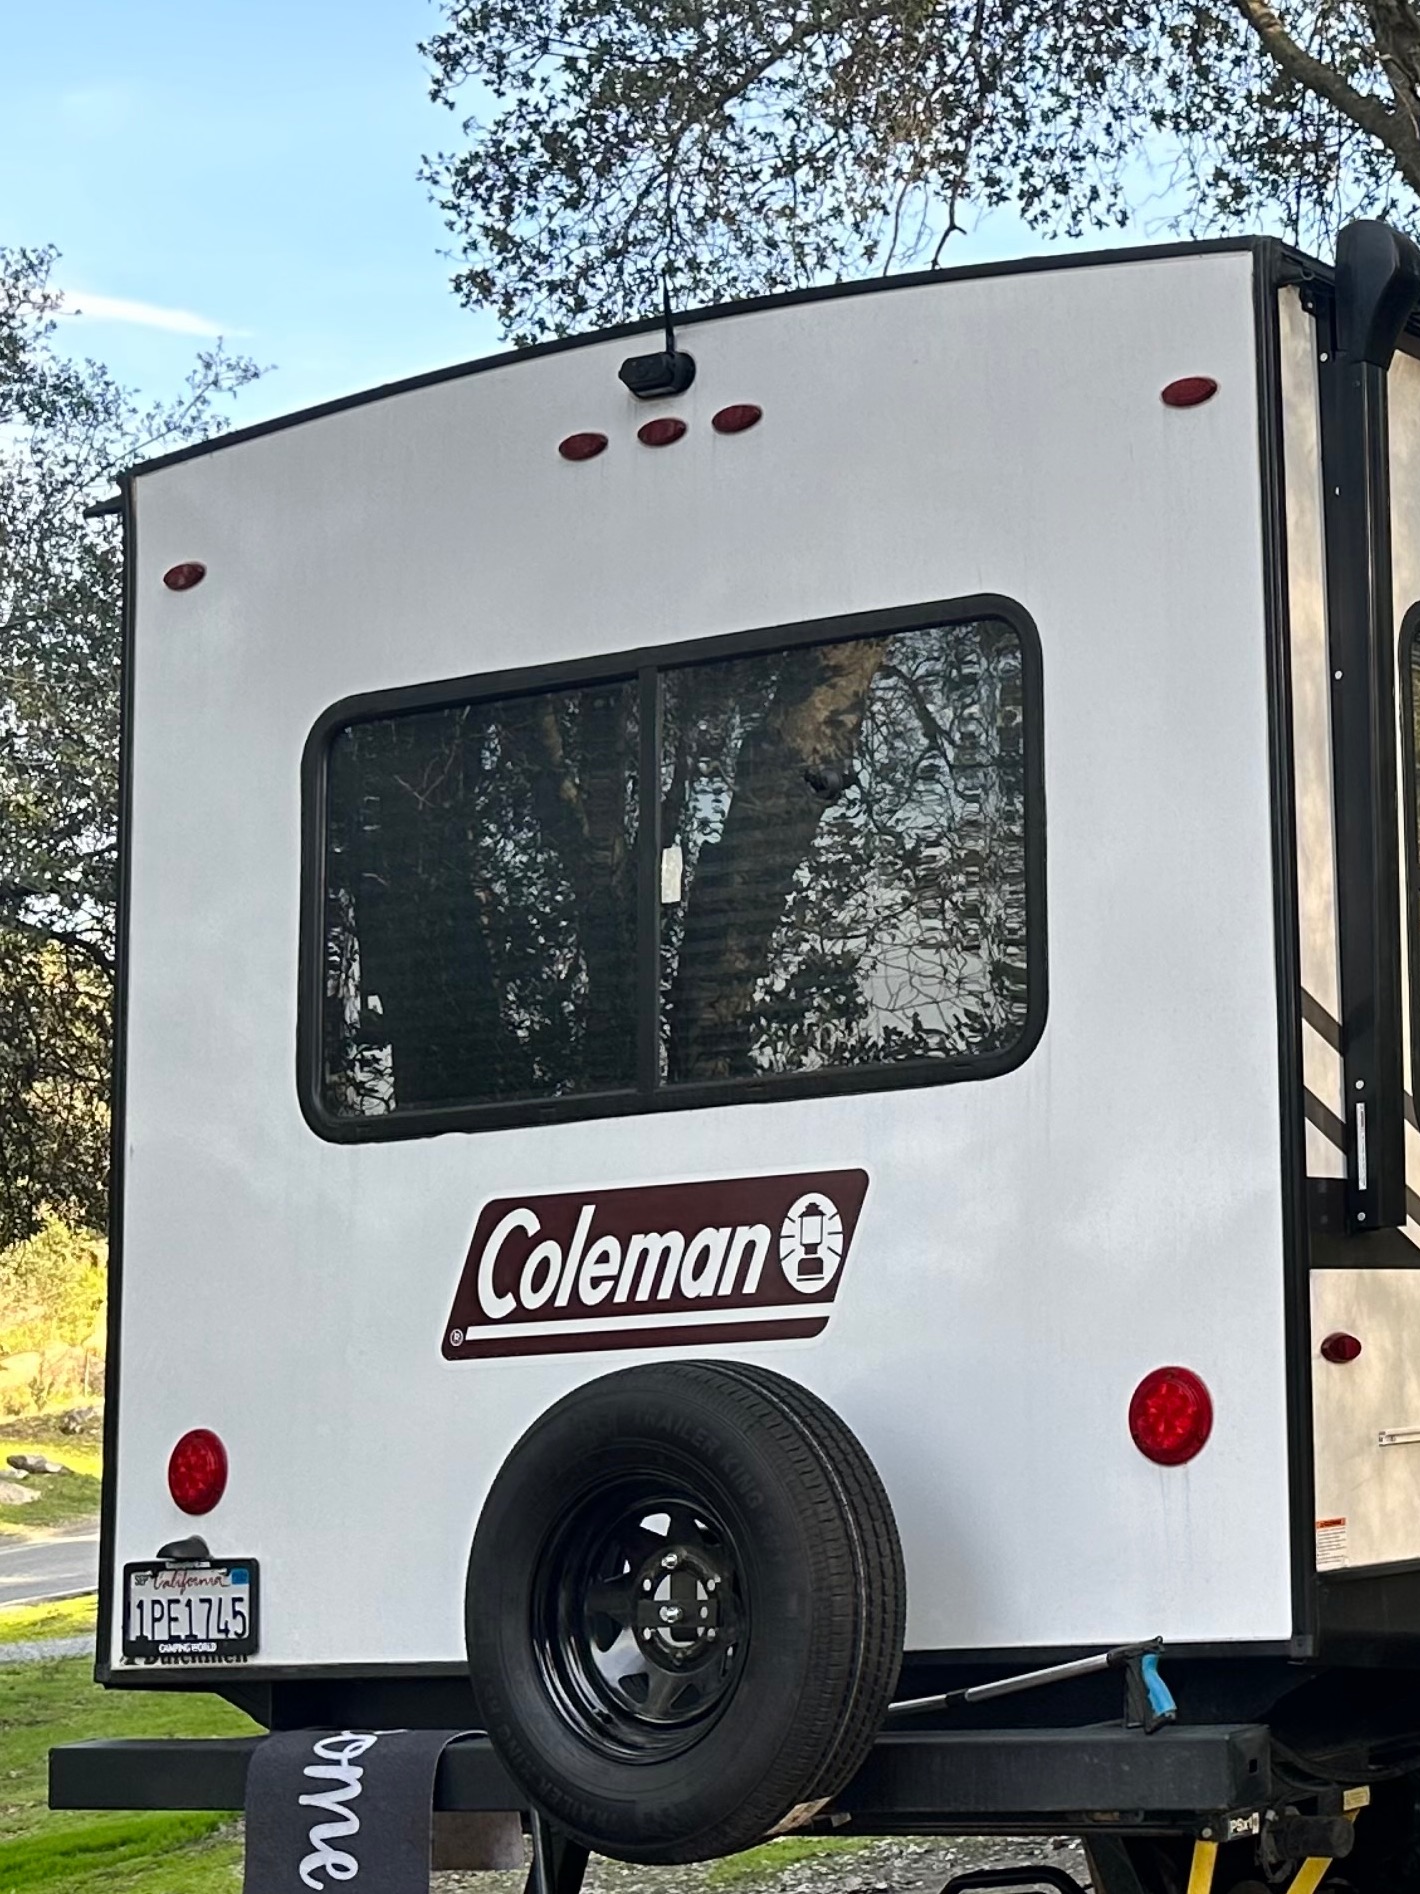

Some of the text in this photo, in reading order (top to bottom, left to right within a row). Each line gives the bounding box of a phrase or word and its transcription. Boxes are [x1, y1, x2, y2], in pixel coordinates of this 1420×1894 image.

[477, 1203, 772, 1319] Coleman
[719, 1453, 765, 1509] KING
[153, 1568, 230, 1596] California
[136, 1596, 248, 1640] 1PE1745
